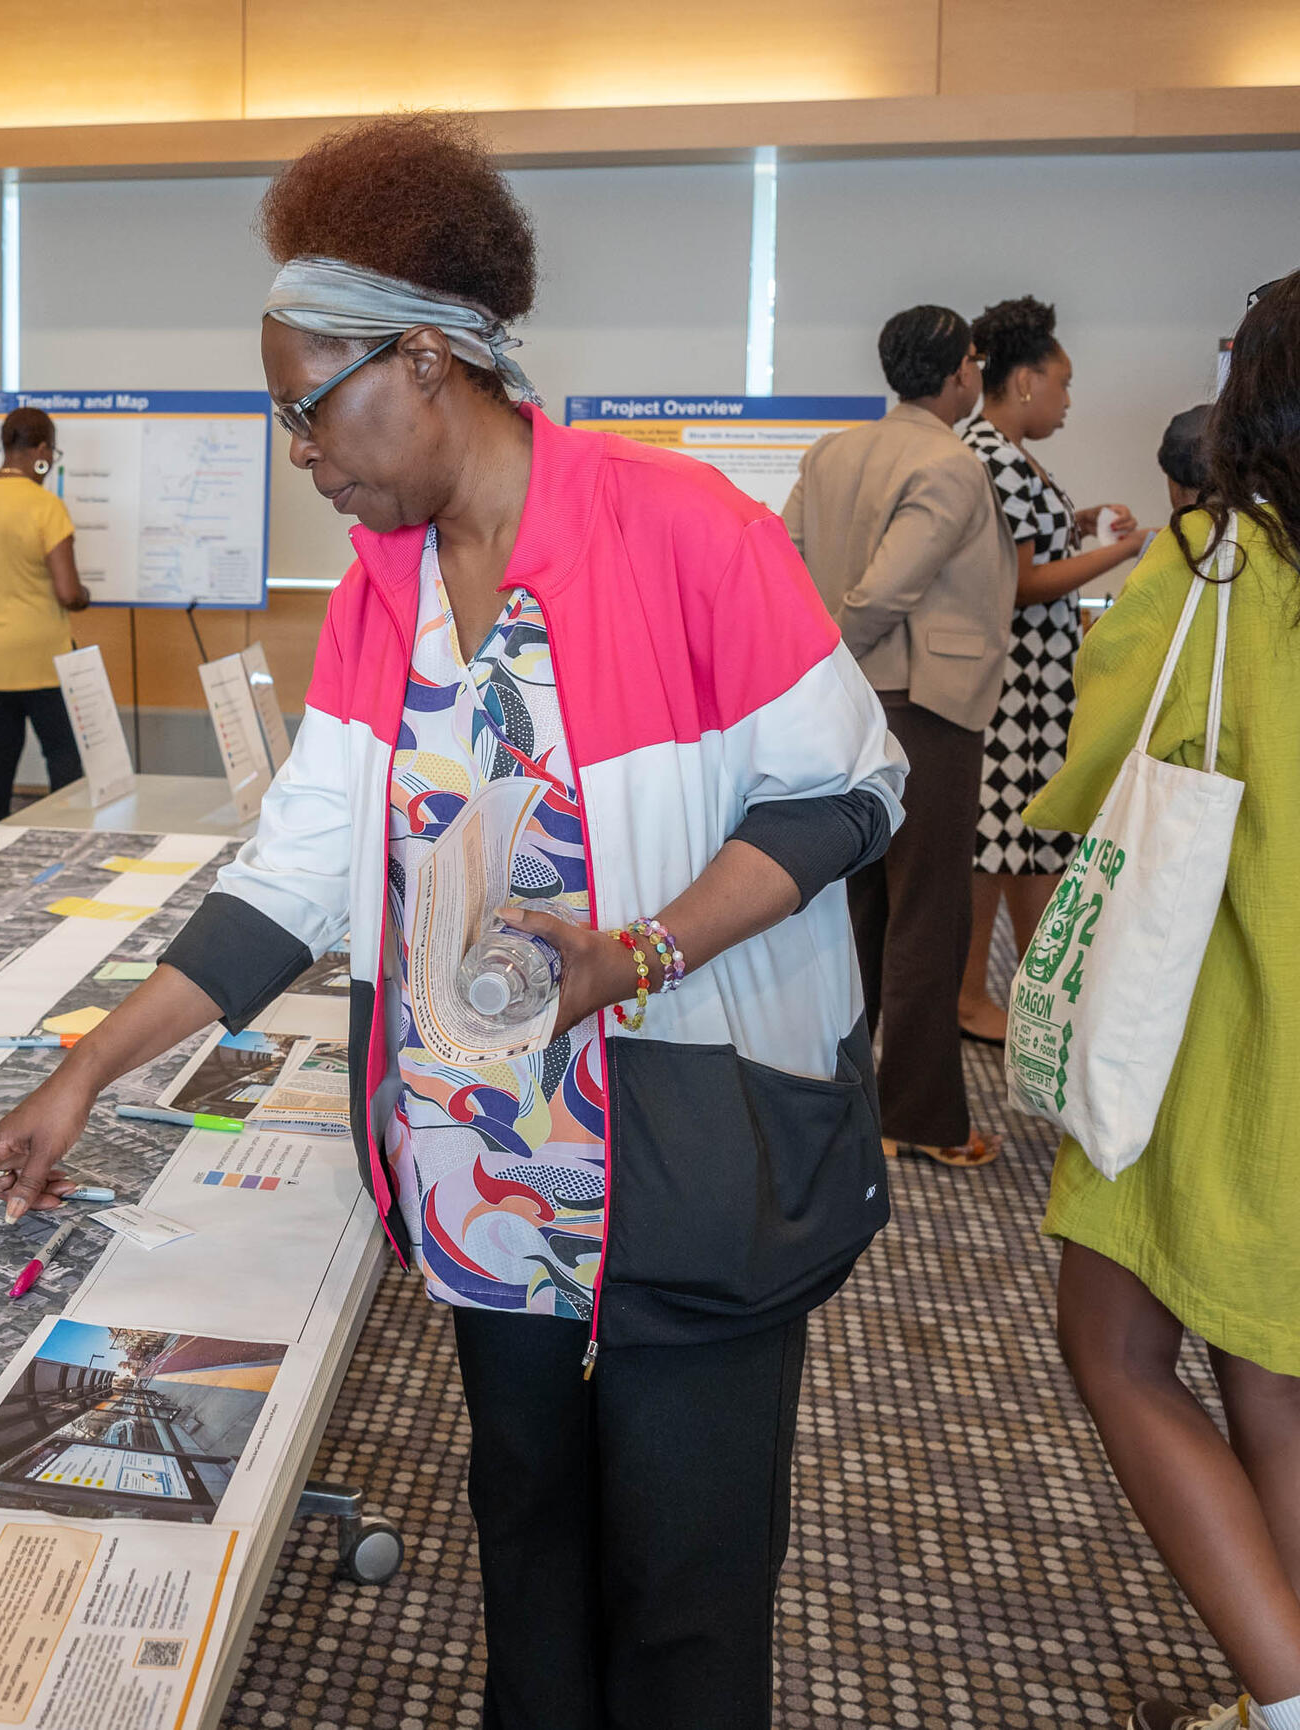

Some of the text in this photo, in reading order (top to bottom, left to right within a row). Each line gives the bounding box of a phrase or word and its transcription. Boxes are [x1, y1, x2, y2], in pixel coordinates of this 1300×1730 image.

[16, 395, 149, 412] Timeline and Map
[601, 400, 743, 419] Project Overview
[425, 864, 433, 899] Plan
[420, 905, 431, 949] Action
[413, 946, 421, 1001] Avenue
